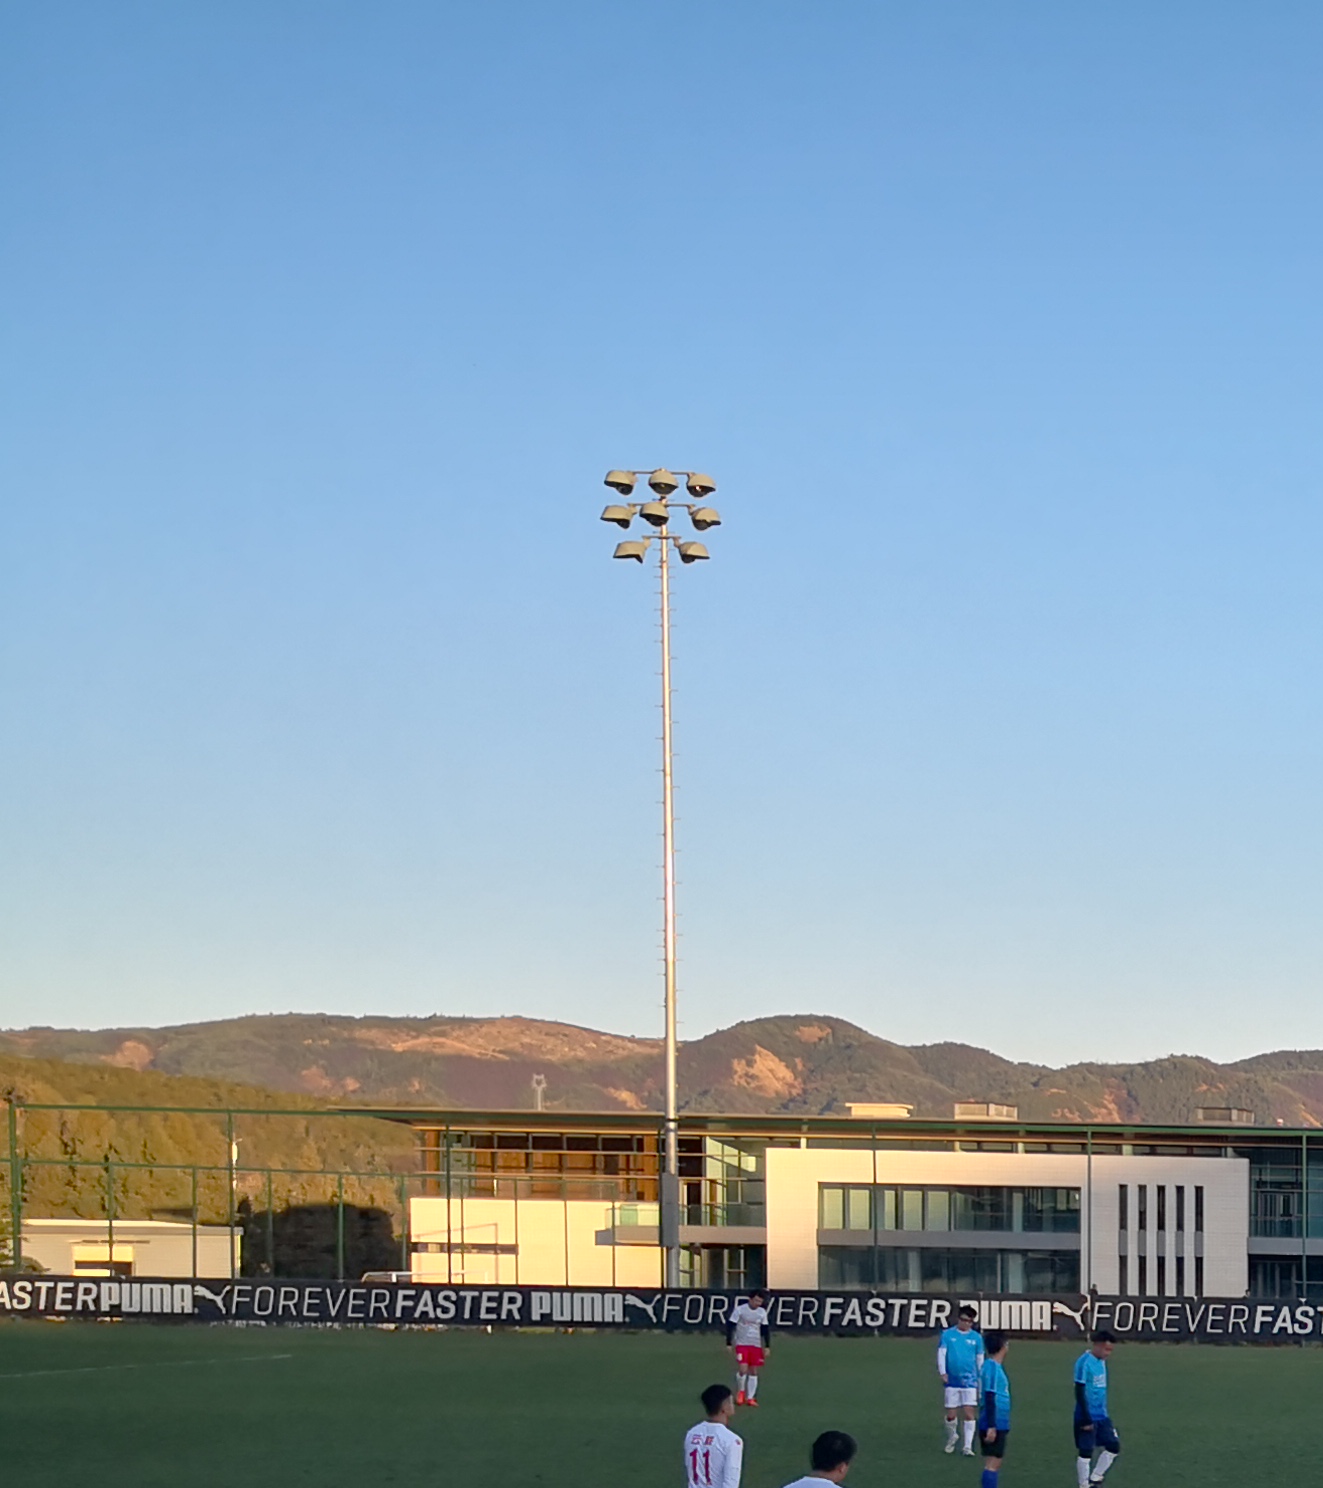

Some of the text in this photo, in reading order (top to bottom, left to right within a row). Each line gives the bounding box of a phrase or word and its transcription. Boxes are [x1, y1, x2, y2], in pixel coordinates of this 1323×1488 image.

[101, 1282, 192, 1313] PUMA
[531, 1292, 623, 1323] PUMA
[689, 1447, 712, 1485] 11
